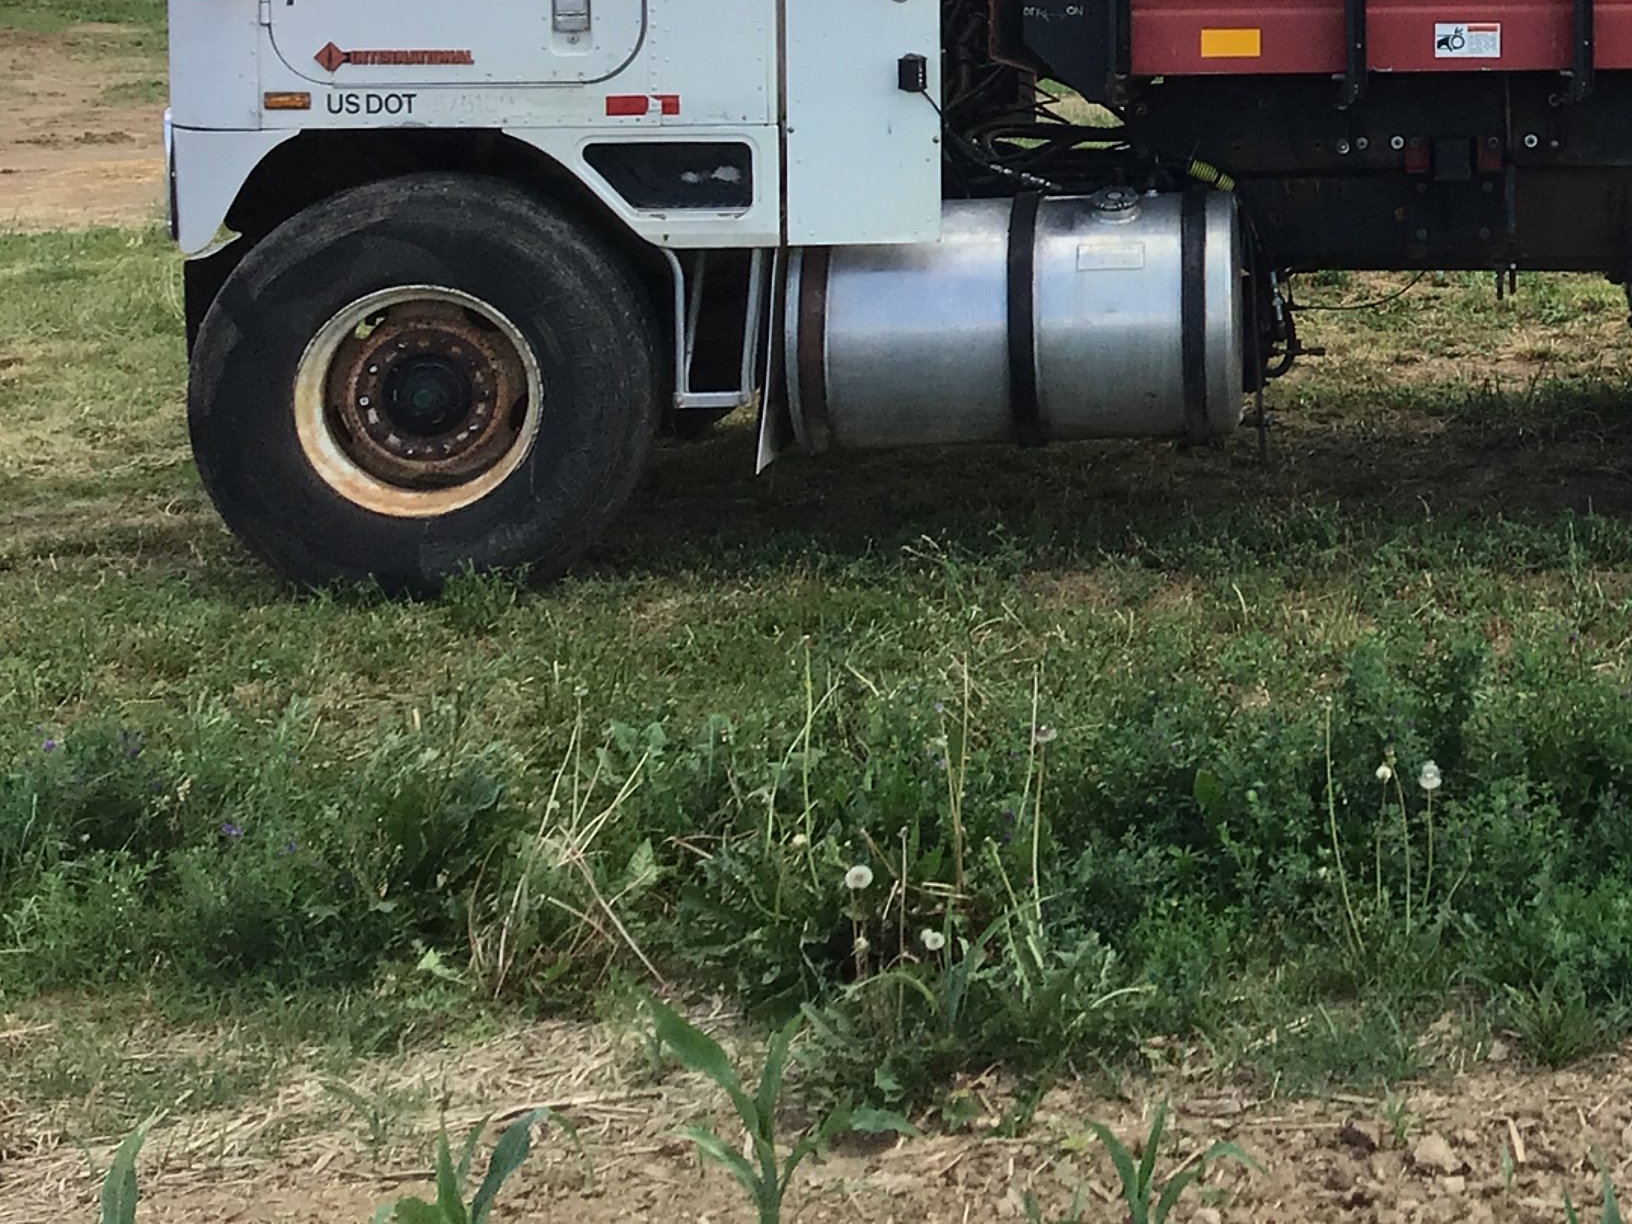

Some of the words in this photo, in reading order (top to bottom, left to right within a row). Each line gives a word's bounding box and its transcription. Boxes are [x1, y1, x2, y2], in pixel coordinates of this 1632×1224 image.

[350, 50, 475, 66] INTERNATIONAL
[327, 93, 360, 114] US
[366, 93, 417, 114] DOT
